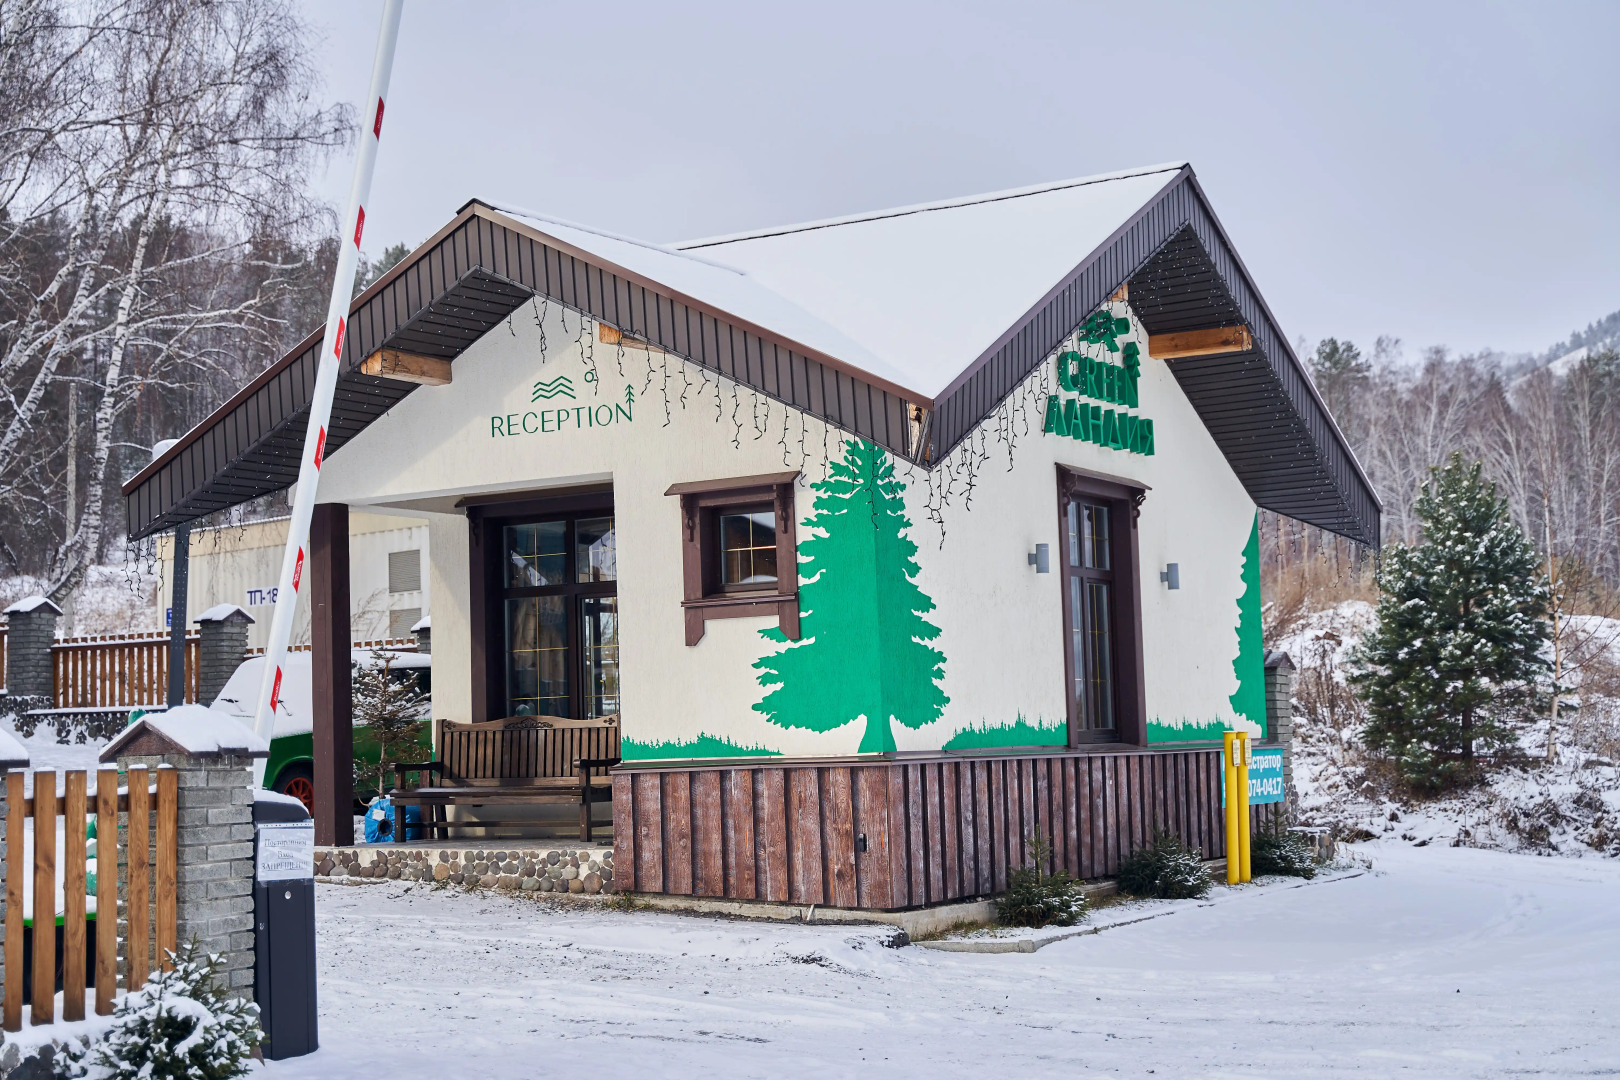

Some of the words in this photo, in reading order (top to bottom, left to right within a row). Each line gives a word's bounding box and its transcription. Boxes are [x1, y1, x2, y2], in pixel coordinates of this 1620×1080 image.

[1058, 347, 1139, 408] GREEN
[491, 395, 633, 438] RECEPTION
[1045, 395, 1155, 456] ЛАНДИЯ
